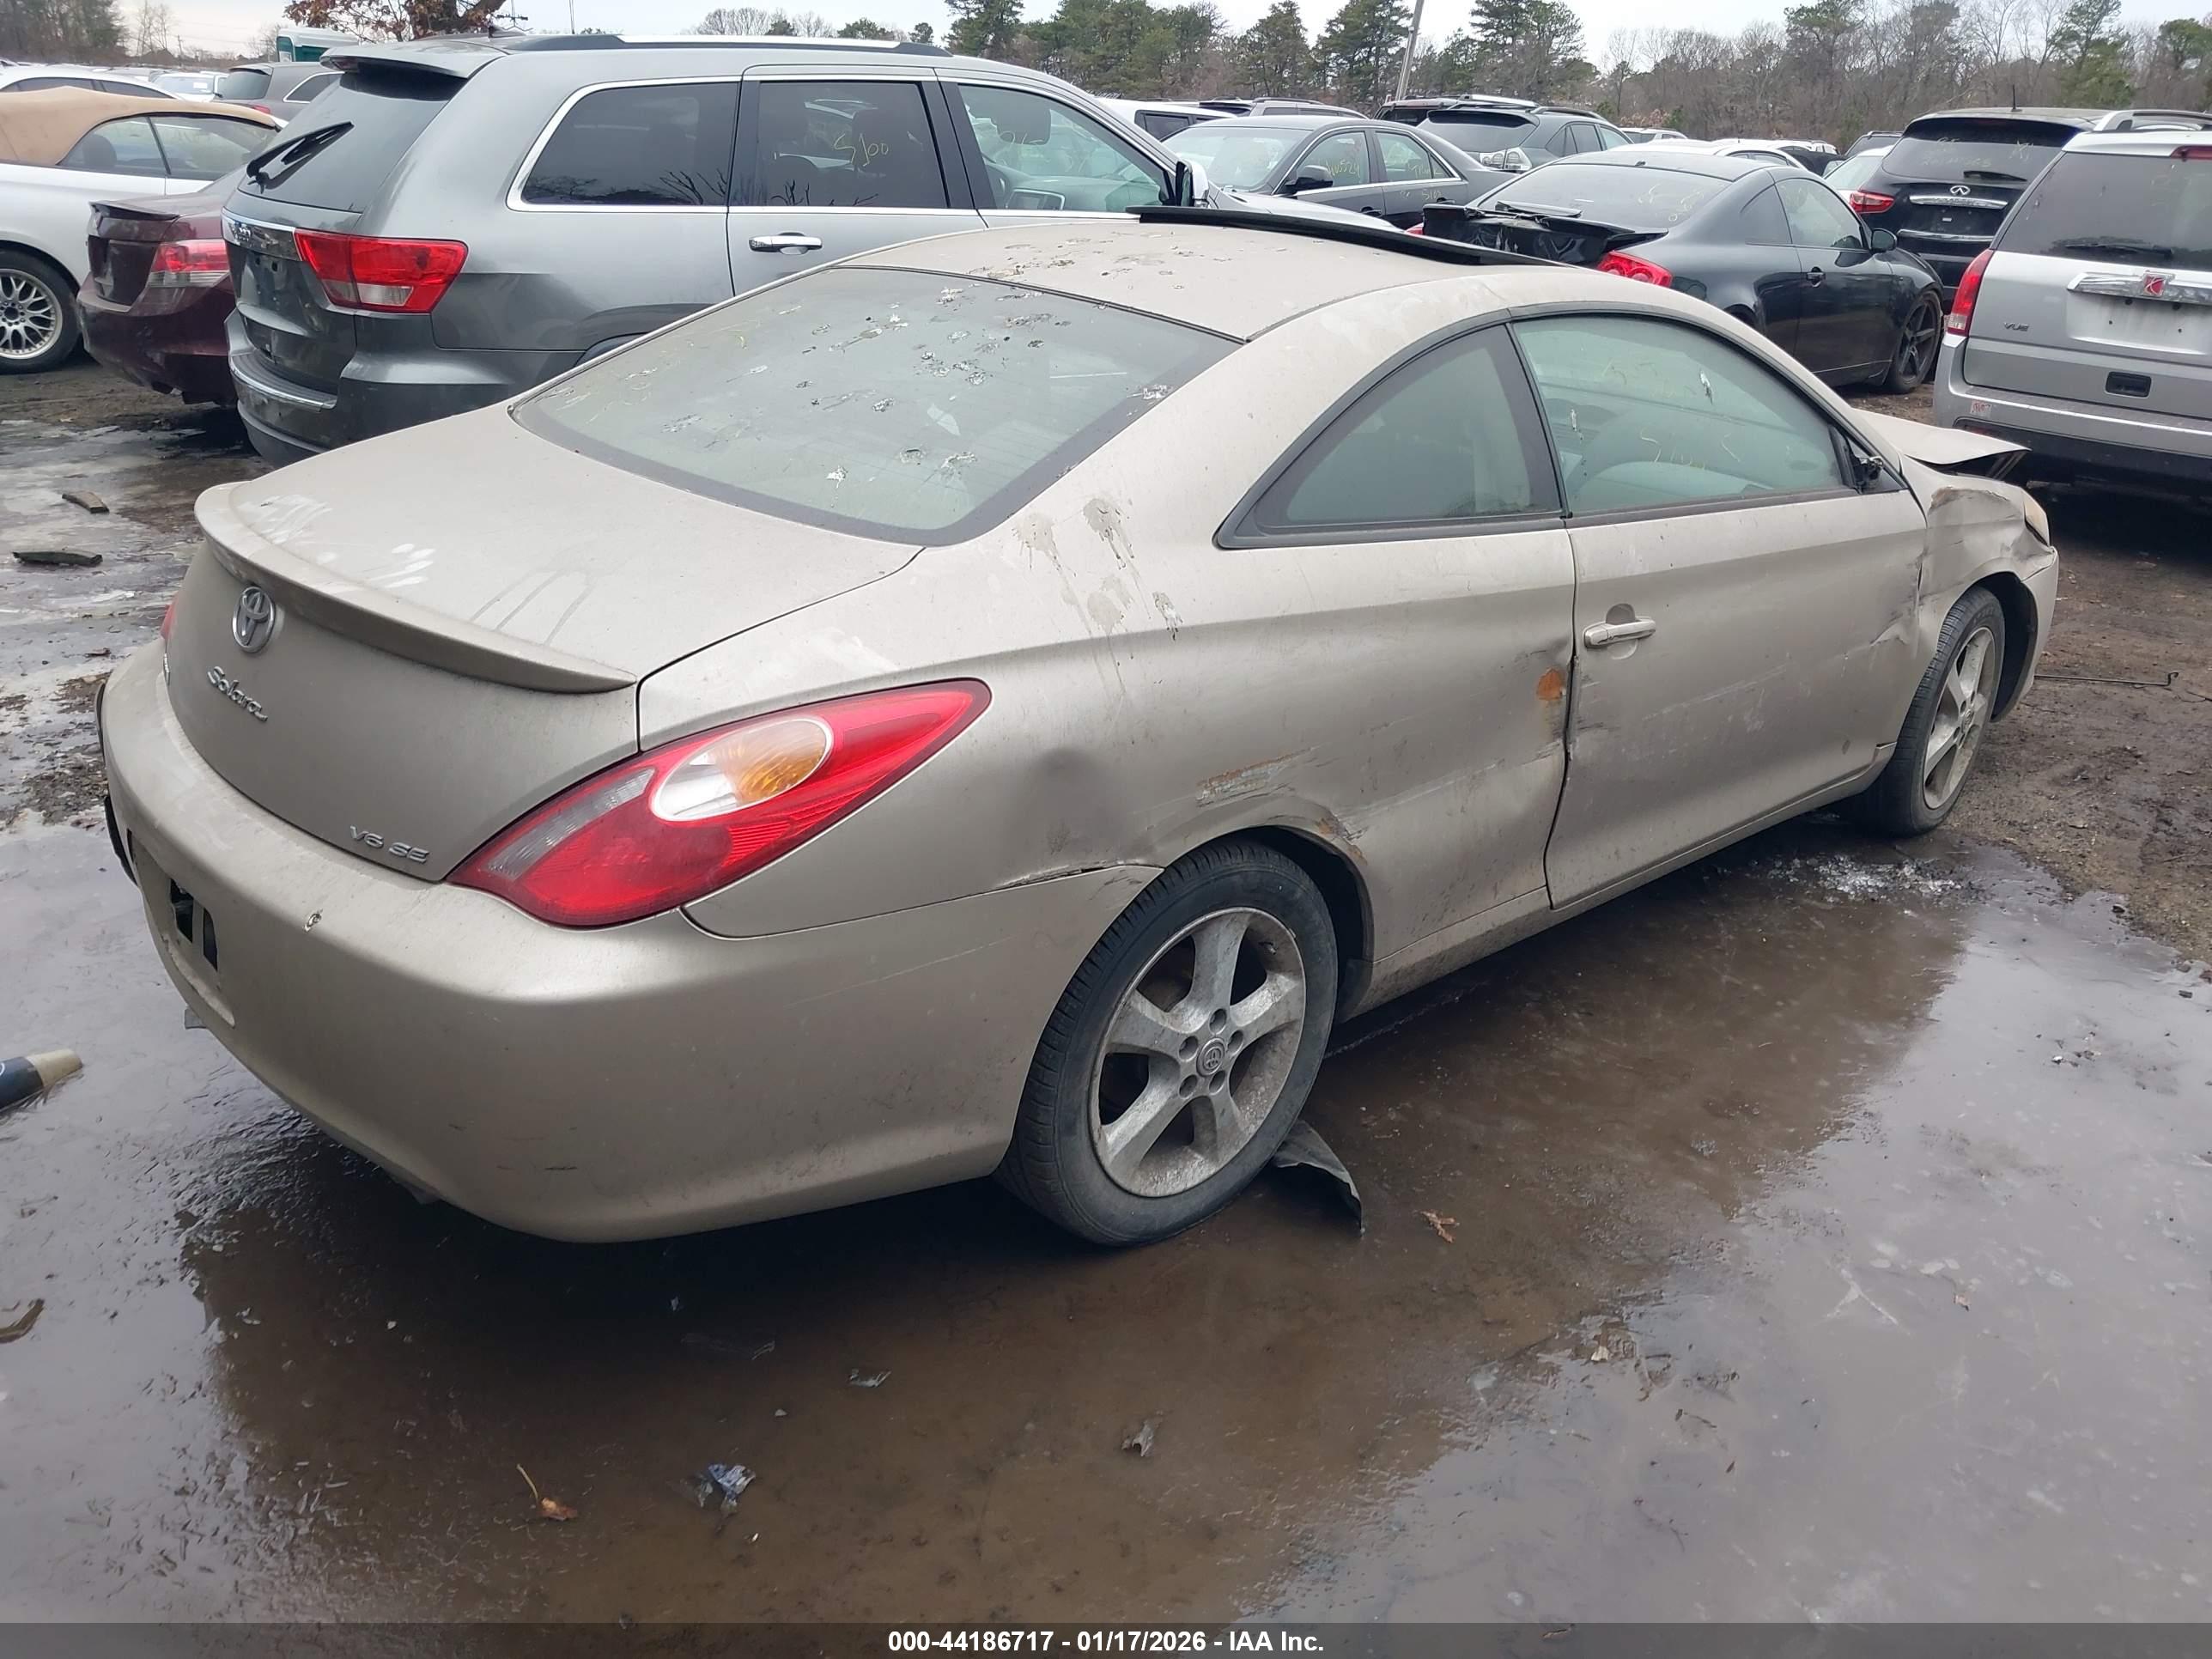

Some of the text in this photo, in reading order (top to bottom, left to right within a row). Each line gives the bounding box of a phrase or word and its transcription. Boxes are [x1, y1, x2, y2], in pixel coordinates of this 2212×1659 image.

[2003, 322, 2029, 331] VUE
[207, 665, 268, 722] Solara
[349, 825, 429, 864] V6 SE
